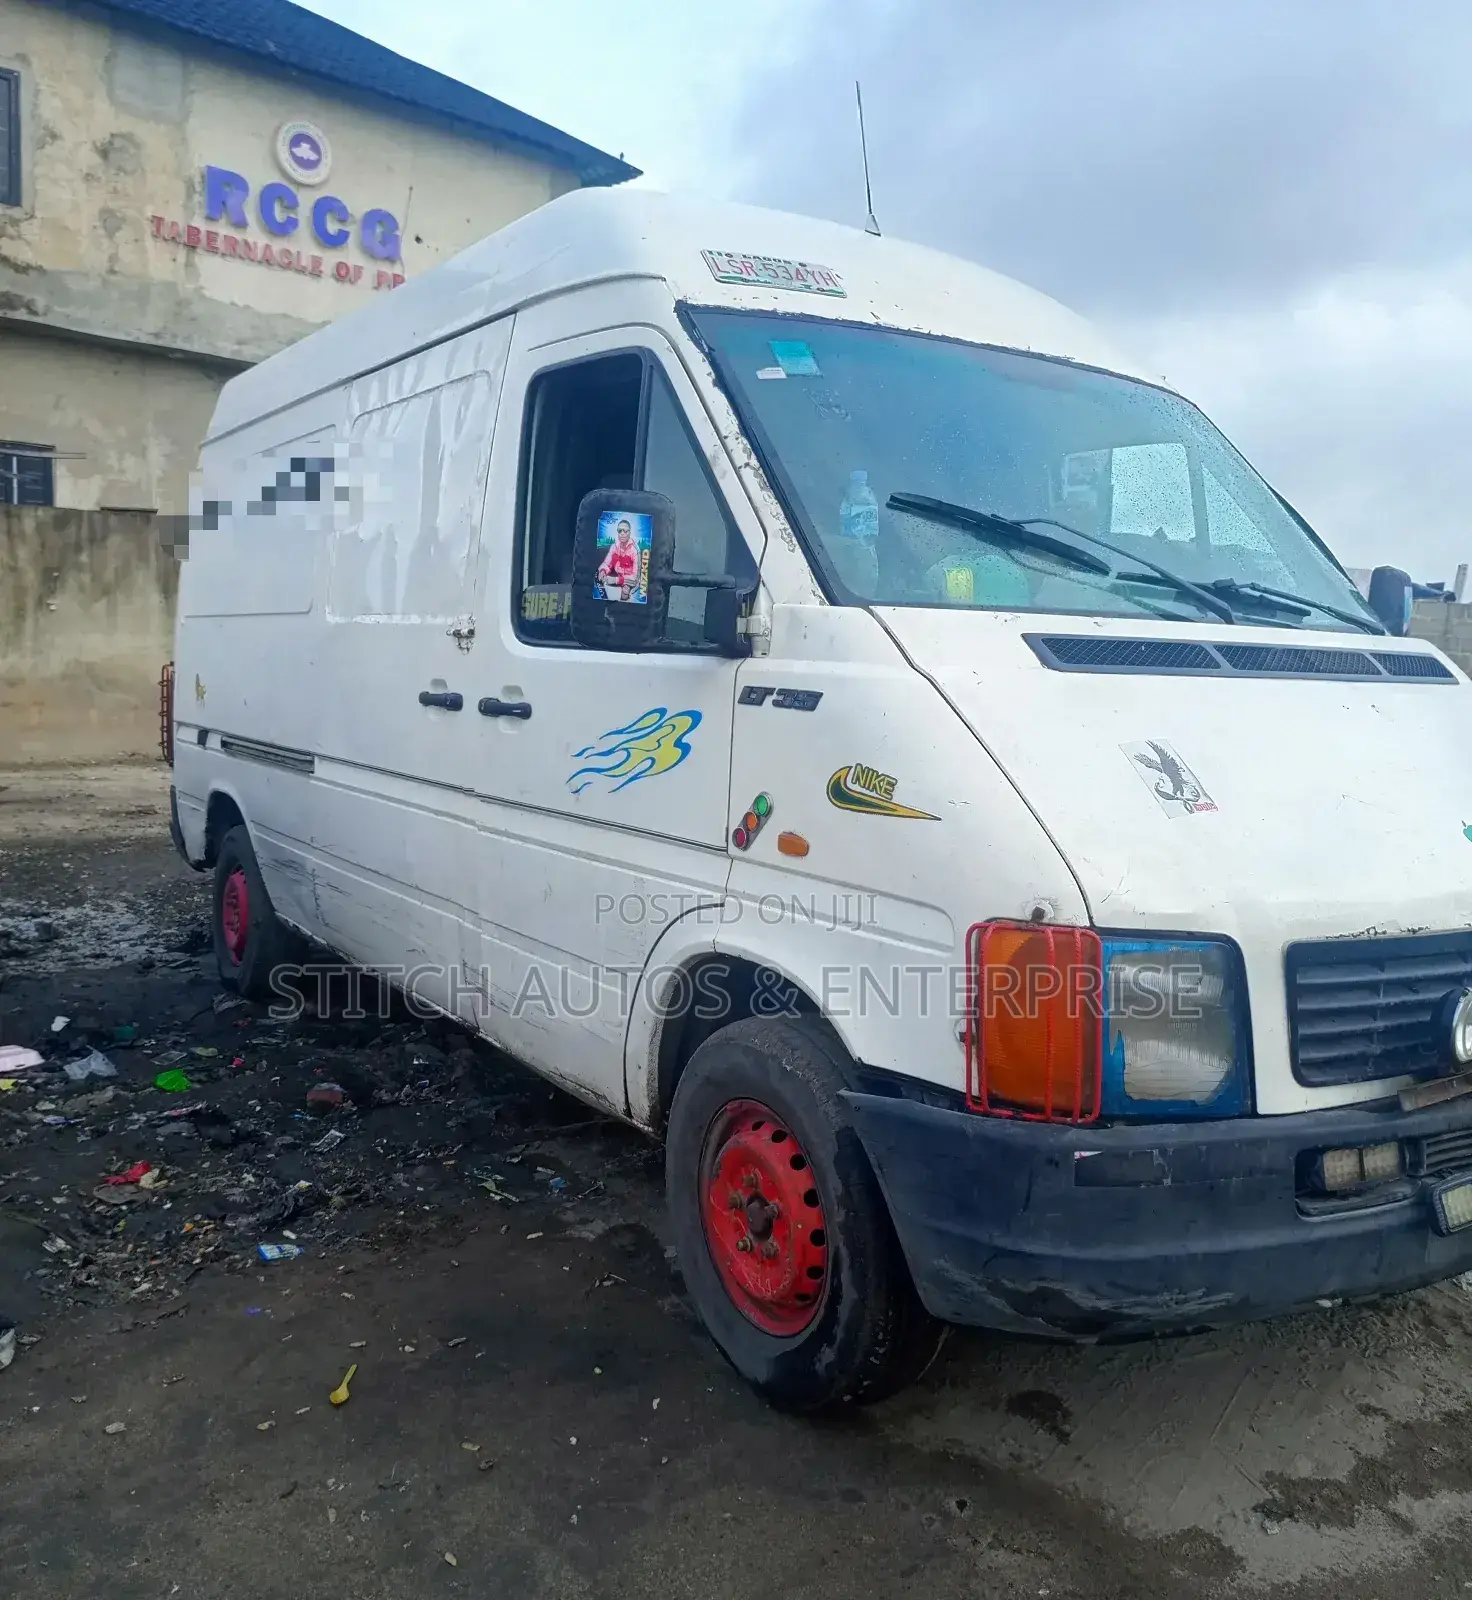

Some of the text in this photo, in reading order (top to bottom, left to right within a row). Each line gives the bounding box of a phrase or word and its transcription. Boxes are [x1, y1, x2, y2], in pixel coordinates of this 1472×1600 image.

[204, 164, 401, 263] RCCG
[334, 260, 365, 285] OF
[521, 592, 557, 620] SURE
[851, 763, 898, 801] NIKE
